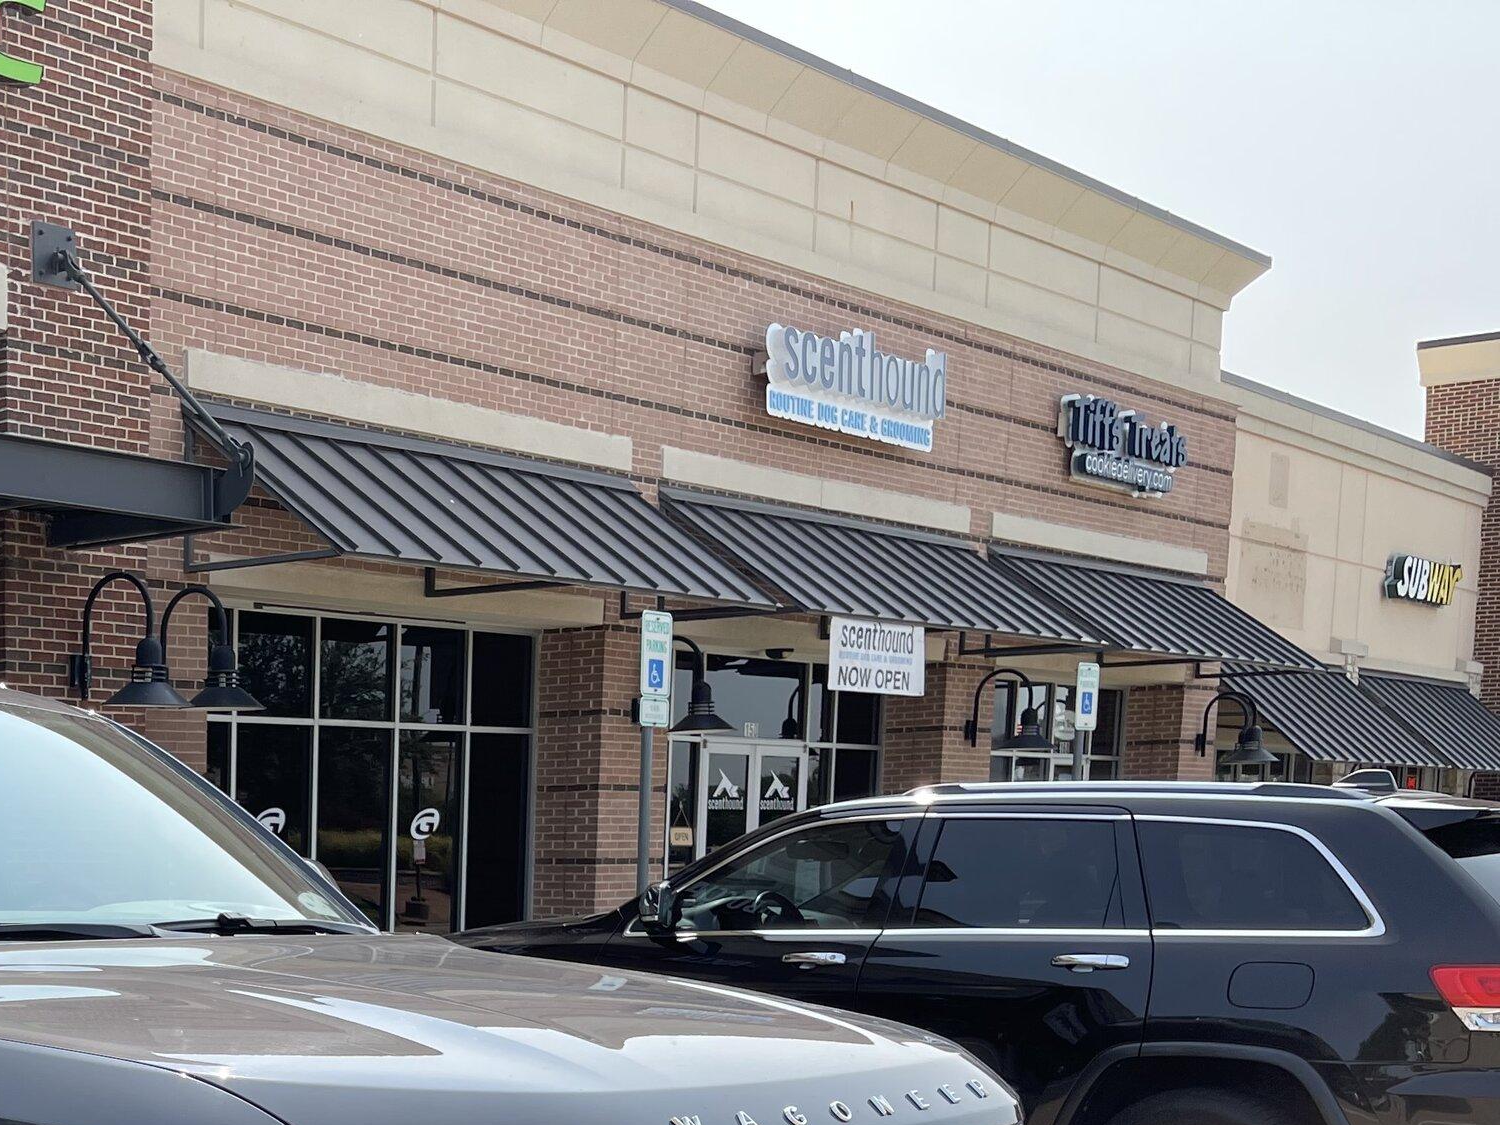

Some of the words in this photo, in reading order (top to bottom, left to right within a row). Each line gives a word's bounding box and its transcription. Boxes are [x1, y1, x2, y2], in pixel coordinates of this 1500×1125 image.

[784, 326, 946, 418] scenthound
[769, 390, 814, 418] ROUTINE
[818, 401, 838, 425] DOG
[841, 408, 867, 431] CARE
[870, 416, 878, 434] &
[881, 419, 931, 446] GROOMING
[1131, 414, 1187, 467] Treats
[1085, 455, 1173, 492] cookiedelivery.com
[1397, 555, 1463, 605] SUBWAY
[841, 622, 914, 654] scenthound
[837, 665, 871, 687] NOW
[875, 669, 910, 691] OPEN
